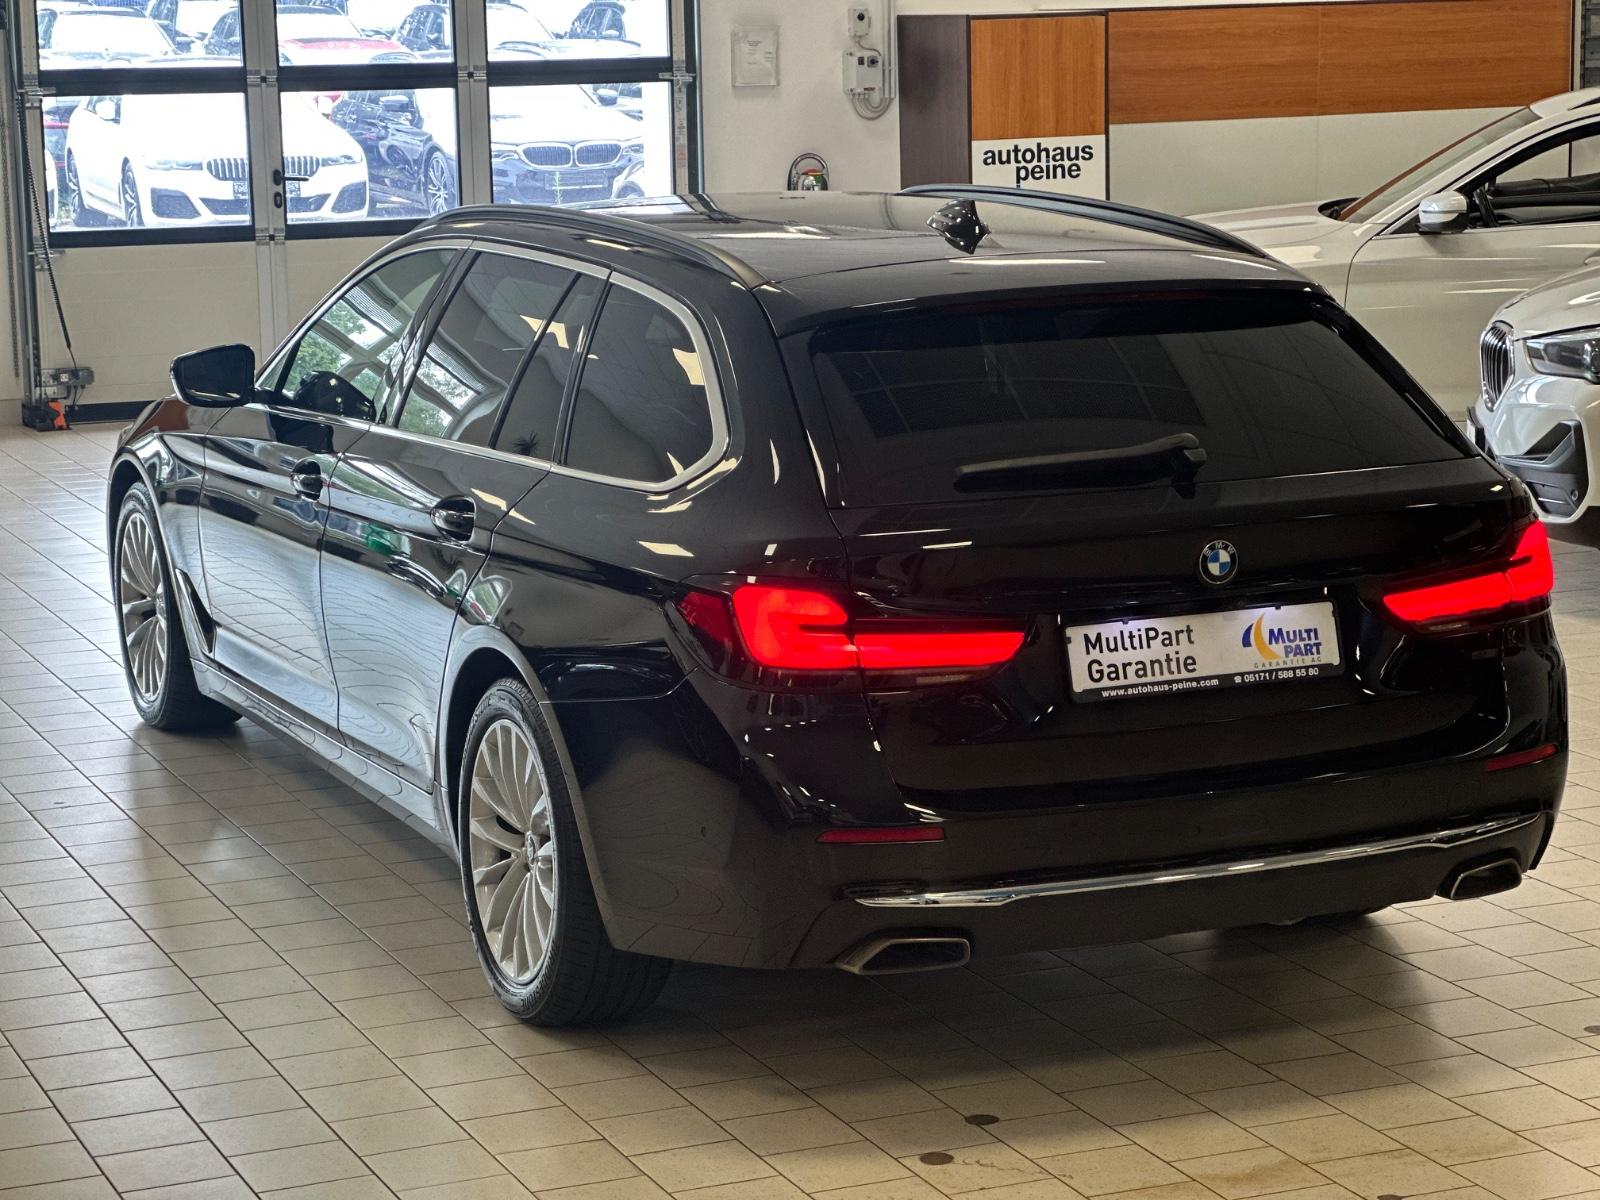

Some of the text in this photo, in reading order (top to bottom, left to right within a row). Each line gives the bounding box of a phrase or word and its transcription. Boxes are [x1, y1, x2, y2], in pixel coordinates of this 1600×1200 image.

[982, 142, 1094, 166] autohaus
[1015, 160, 1082, 188] peine
[1083, 624, 1195, 655] MultiPart
[1283, 642, 1322, 658] PART
[1087, 650, 1198, 683] Garantie
[1254, 657, 1306, 669] GARANTIE
[1244, 672, 1269, 682] 05171
[1277, 669, 1294, 679] 588
[1101, 678, 1219, 698] www.autohaus-peine.com
